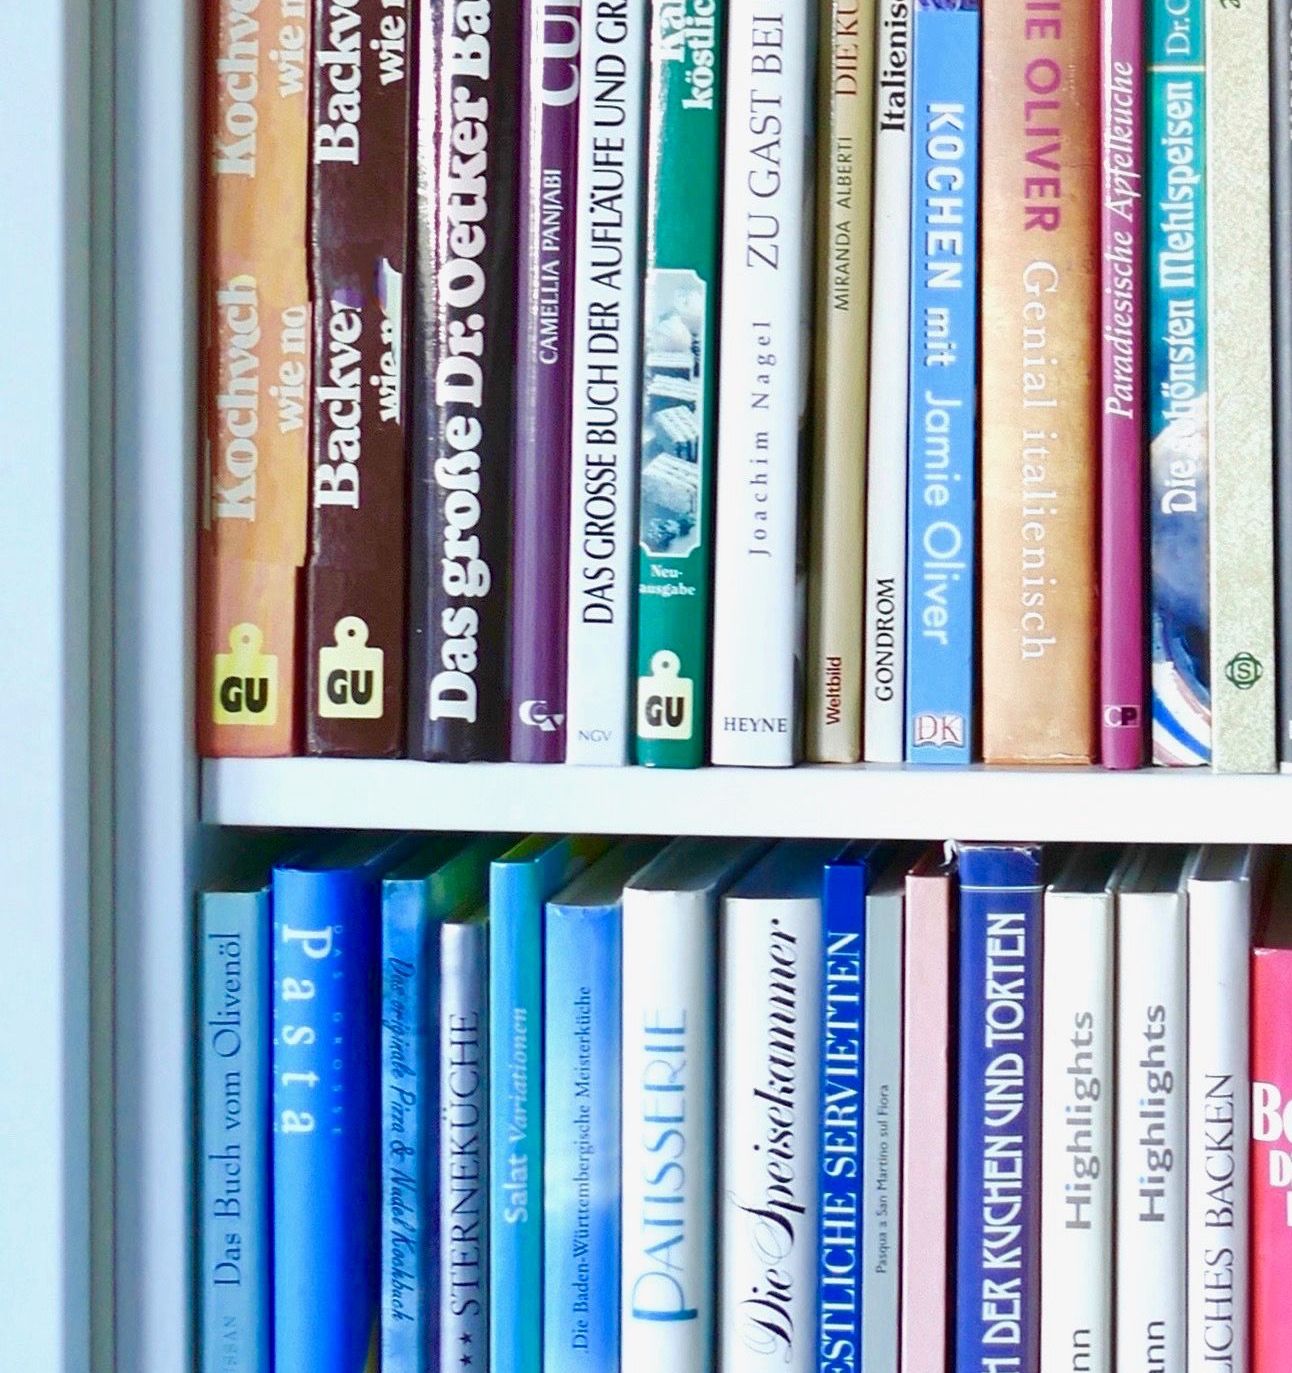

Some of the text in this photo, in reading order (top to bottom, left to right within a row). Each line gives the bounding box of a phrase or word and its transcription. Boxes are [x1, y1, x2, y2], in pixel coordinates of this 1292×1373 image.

[751, 4, 784, 77] BEI
[594, 55, 625, 126] UND
[749, 90, 782, 199] GAST
[1025, 58, 1059, 232] OLIVER
[439, 86, 488, 308] Oetker
[590, 138, 624, 290] AUFLÄUFE
[747, 215, 779, 269] ZU
[432, 313, 484, 408] Dr.
[589, 303, 618, 353] DER
[752, 323, 776, 408] Nagel
[587, 365, 618, 444] BUCH
[432, 417, 486, 598] große
[584, 455, 616, 559] GROSSE
[749, 432, 770, 554] Joachim
[583, 568, 614, 623] DAS
[876, 579, 893, 701] GONDROM
[432, 609, 479, 722] Das
[825, 933, 864, 1177] SERVIETTEN
[878, 1085, 888, 1115] Fiora
[209, 935, 244, 1284] Das Buch vom Olivenöl
[878, 1121, 888, 1136] sul
[1066, 1013, 1102, 1229] Highlights
[877, 1142, 887, 1190] Martino
[877, 1196, 887, 1216] San
[876, 1233, 890, 1273] Pasqua
